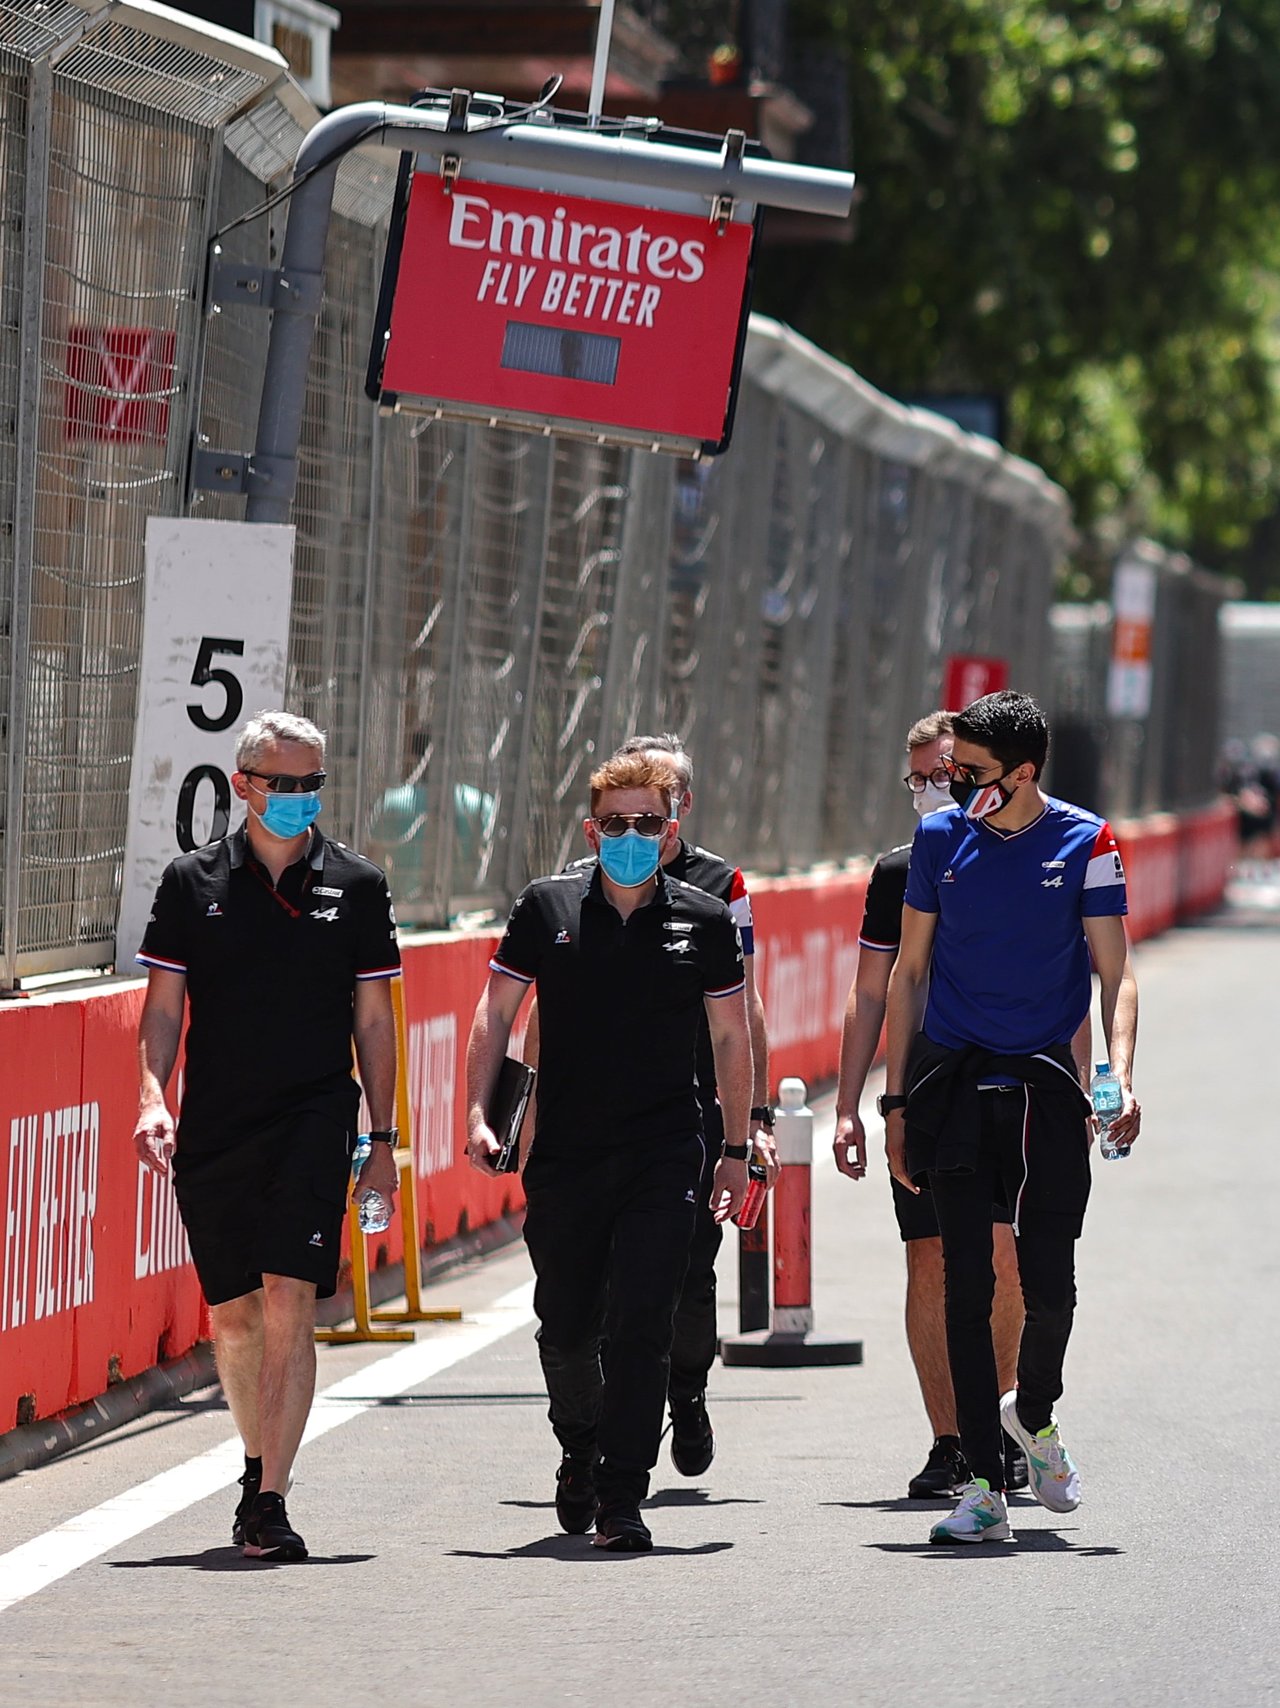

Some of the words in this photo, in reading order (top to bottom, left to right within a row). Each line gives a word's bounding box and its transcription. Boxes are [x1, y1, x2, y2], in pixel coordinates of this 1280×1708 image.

[449, 193, 705, 283] Emirates
[476, 260, 537, 308] FLY
[540, 270, 661, 328] BETTER
[1, 1114, 38, 1332] FLY
[34, 1101, 100, 1321] BETTER
